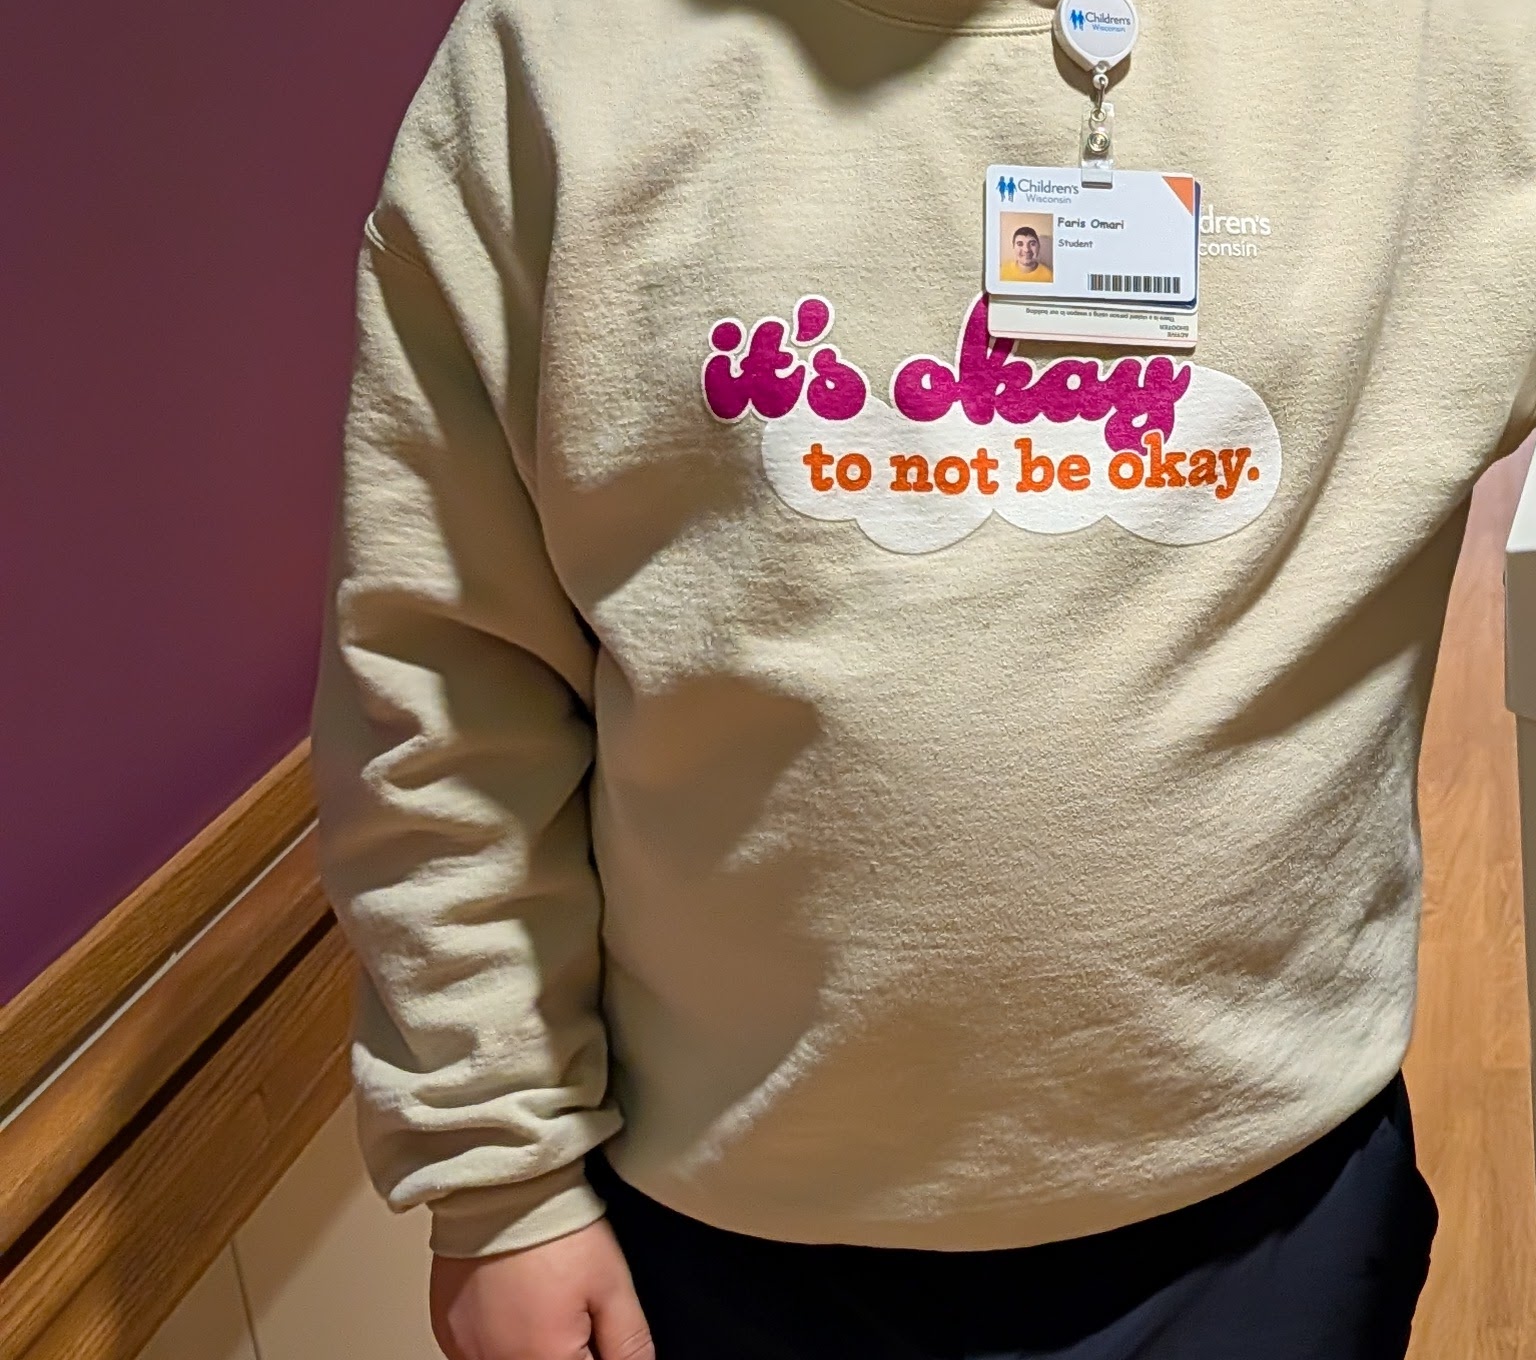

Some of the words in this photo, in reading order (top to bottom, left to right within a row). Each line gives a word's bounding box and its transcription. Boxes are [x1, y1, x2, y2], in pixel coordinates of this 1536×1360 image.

[1085, 11, 1131, 26] Children's
[1018, 178, 1079, 195] Children's
[1026, 194, 1072, 204] Wisconsin
[1057, 217, 1086, 228] Faris
[1090, 218, 1125, 230] Omari
[1200, 204, 1271, 236] dren's
[1058, 238, 1093, 248] Student
[1199, 242, 1258, 257] consin
[704, 298, 867, 421] it's
[893, 290, 1192, 457] okay
[802, 442, 873, 493] to
[889, 447, 999, 496] not
[1014, 437, 1091, 494] be
[1108, 431, 1261, 500] okay.
